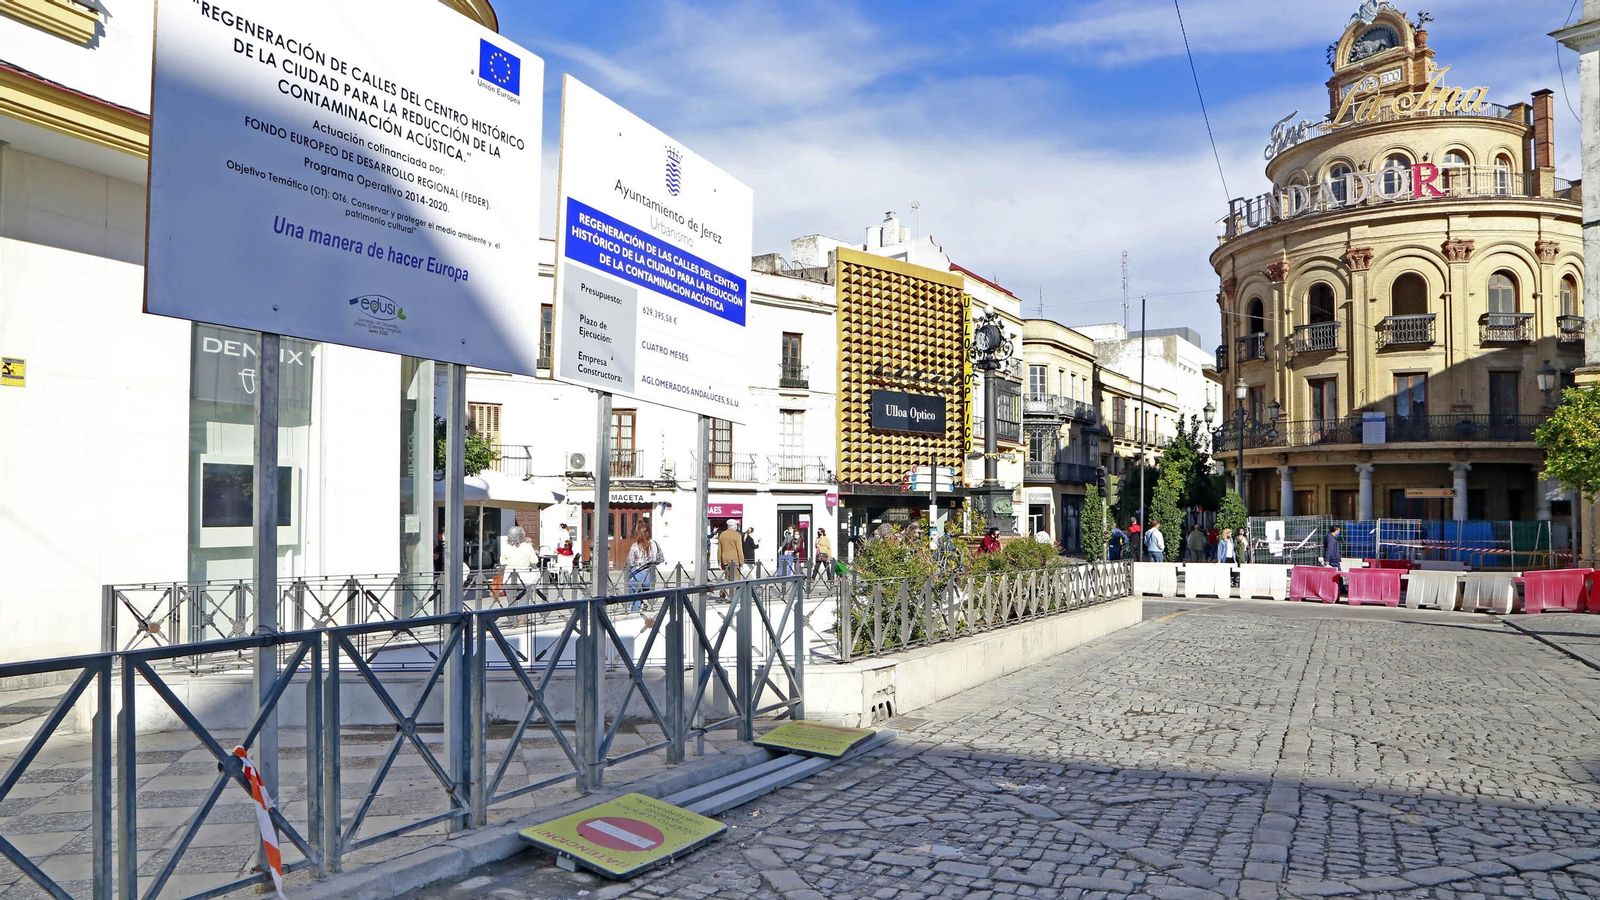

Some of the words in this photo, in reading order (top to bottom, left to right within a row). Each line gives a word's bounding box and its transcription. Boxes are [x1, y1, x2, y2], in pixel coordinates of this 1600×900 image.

[233, 38, 254, 59] DE
[259, 48, 277, 68] LA
[282, 59, 339, 92] CIUDAD
[344, 83, 379, 109] PARA
[383, 99, 398, 116] LA
[402, 107, 470, 145] REDUCCIÓN
[473, 137, 486, 152] DE
[489, 144, 501, 158] LA
[278, 79, 402, 137] CONTAMINACIÓN
[331, 57, 348, 75] DE
[351, 66, 397, 96] CALLES
[401, 87, 421, 107] DEL
[424, 98, 468, 126] CENTRO
[471, 118, 525, 150] HISTÓRICO
[477, 79, 495, 93] Unión
[496, 88, 521, 105] Europea
[1264, 110, 1314, 161] Fino
[1316, 72, 1385, 132] La
[1391, 62, 1492, 116] Ina
[245, 116, 287, 139] FONDO
[290, 132, 339, 157] EUROPEO
[341, 149, 354, 162] DE
[356, 154, 415, 182] DESARROLLO
[417, 175, 460, 199] REGIONAL
[461, 191, 491, 210] (FEDER).
[312, 120, 365, 146] Actuación
[367, 140, 427, 169] cofinanciada
[429, 164, 446, 176] por:
[226, 160, 266, 179] Objetivo
[268, 172, 309, 192] Temático
[310, 185, 330, 199] (OT):
[332, 192, 349, 204] OT6.
[351, 197, 390, 215] Conservar
[396, 212, 427, 227] proteger
[428, 221, 435, 229] el
[435, 224, 457, 236] medio
[458, 231, 487, 246] ambiente
[304, 157, 354, 182] Programa
[356, 174, 403, 198] Operativo
[405, 190, 450, 213] 2014-2020.
[614, 179, 685, 225] Ayuntamiento
[687, 217, 699, 232] de
[700, 223, 722, 244] Jerez
[1228, 163, 1446, 239] FUNDADOR
[345, 207, 386, 226] patrimonio
[650, 214, 694, 248] Urbanismo
[273, 215, 304, 239] Una
[308, 228, 363, 255] manera
[367, 242, 384, 260] de
[387, 246, 424, 270] hacer
[426, 256, 469, 283] Europa
[571, 225, 621, 255] HISTÓRICO
[622, 247, 633, 260] DE
[634, 252, 646, 266] LA
[646, 258, 676, 278] CIUDAD
[677, 270, 695, 287] PARA
[696, 279, 705, 291] LA
[706, 283, 743, 307] REDUCCIÓN
[579, 212, 645, 251] REGENERACIÓN
[646, 242, 657, 256] DE
[658, 248, 672, 262] LAS
[672, 255, 699, 275] CALLES
[700, 267, 713, 281] DEL
[713, 273, 739, 292] CENTRO
[580, 283, 623, 305] Presupuesto:
[599, 252, 611, 267] DE
[612, 258, 624, 272] LA
[691, 291, 725, 312] ACÚSTICA
[579, 314, 598, 328] Plazo
[599, 321, 608, 331] de
[579, 326, 613, 344] Ejecución:
[963, 297, 972, 363] ULLOA
[203, 336, 304, 366] DENIX
[577, 363, 623, 383] Constructora:
[578, 351, 607, 367] Empresa
[641, 340, 669, 355] CUATRO
[669, 349, 689, 362] MESES
[641, 375, 690, 395] AGLOMERADOS
[885, 403, 908, 418] Ulloa
[909, 406, 936, 422] Optico
[963, 373, 972, 452] OPTICO
[615, 802, 657, 820] CLIENTES
